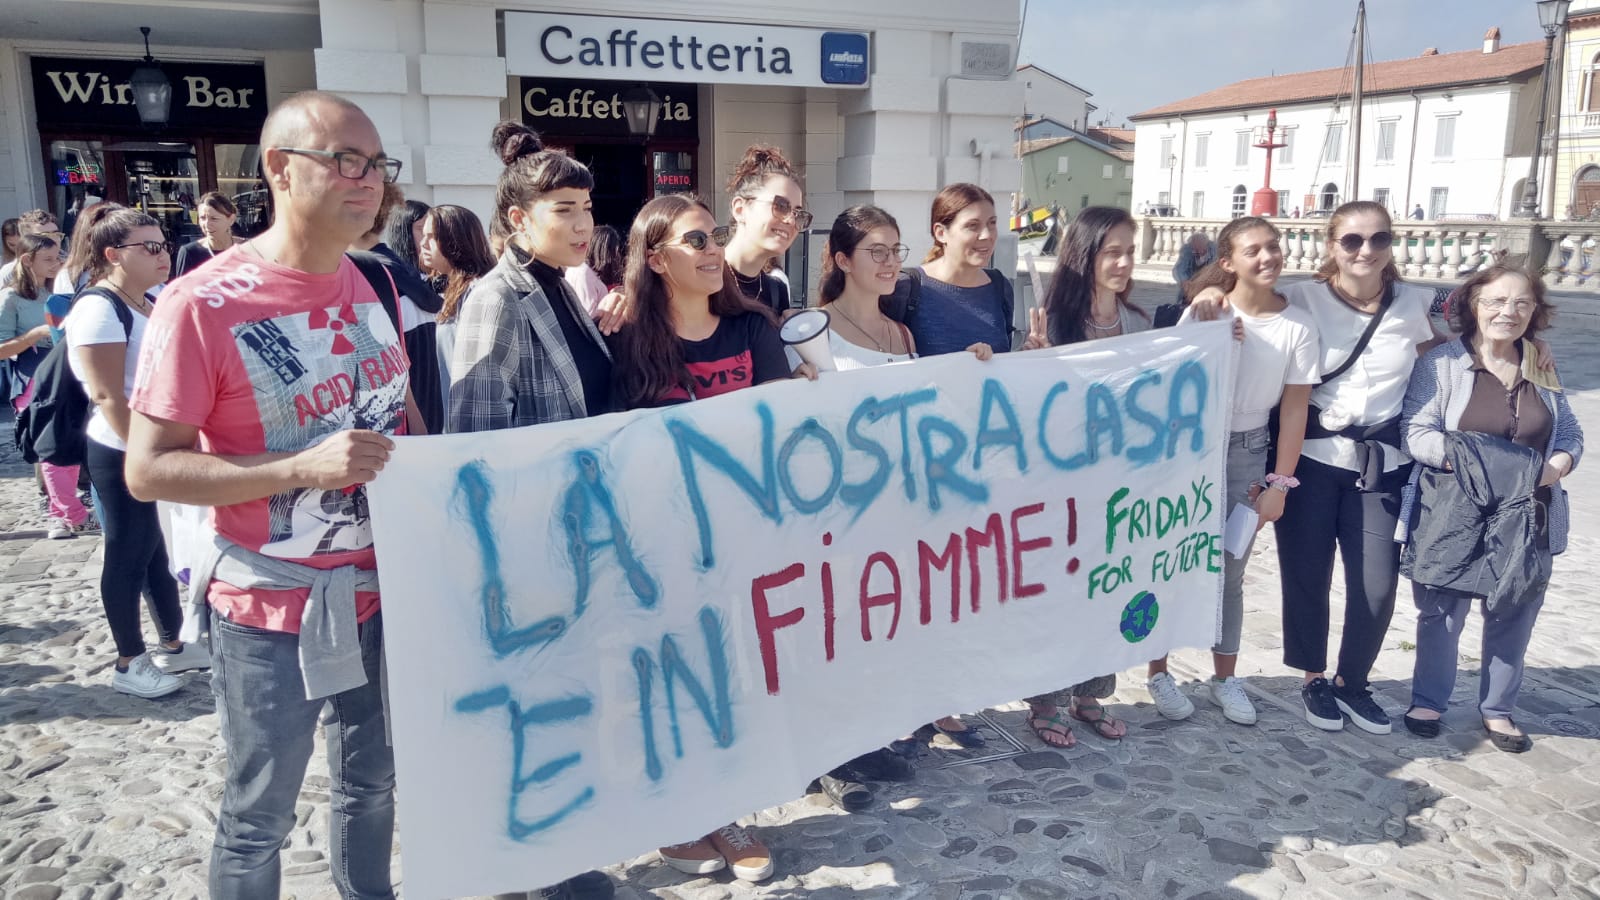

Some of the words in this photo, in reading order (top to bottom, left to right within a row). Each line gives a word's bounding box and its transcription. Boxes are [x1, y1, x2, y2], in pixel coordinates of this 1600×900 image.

[540, 25, 793, 74] Caffetteria
[46, 71, 137, 105] Win
[183, 76, 254, 109] Bar
[524, 87, 692, 121] Caffetia
[69, 171, 99, 184] BAR
[657, 175, 690, 185] APERTO
[193, 263, 264, 309] STOP
[694, 365, 748, 388] VI'S
[294, 372, 354, 427] ACID
[457, 450, 661, 657] LA
[666, 377, 1029, 572] NOSTRA
[1038, 359, 1209, 472] CASA
[1105, 475, 1214, 555] FRIDAYS
[1088, 555, 1134, 600] FOR
[631, 605, 736, 783] IN
